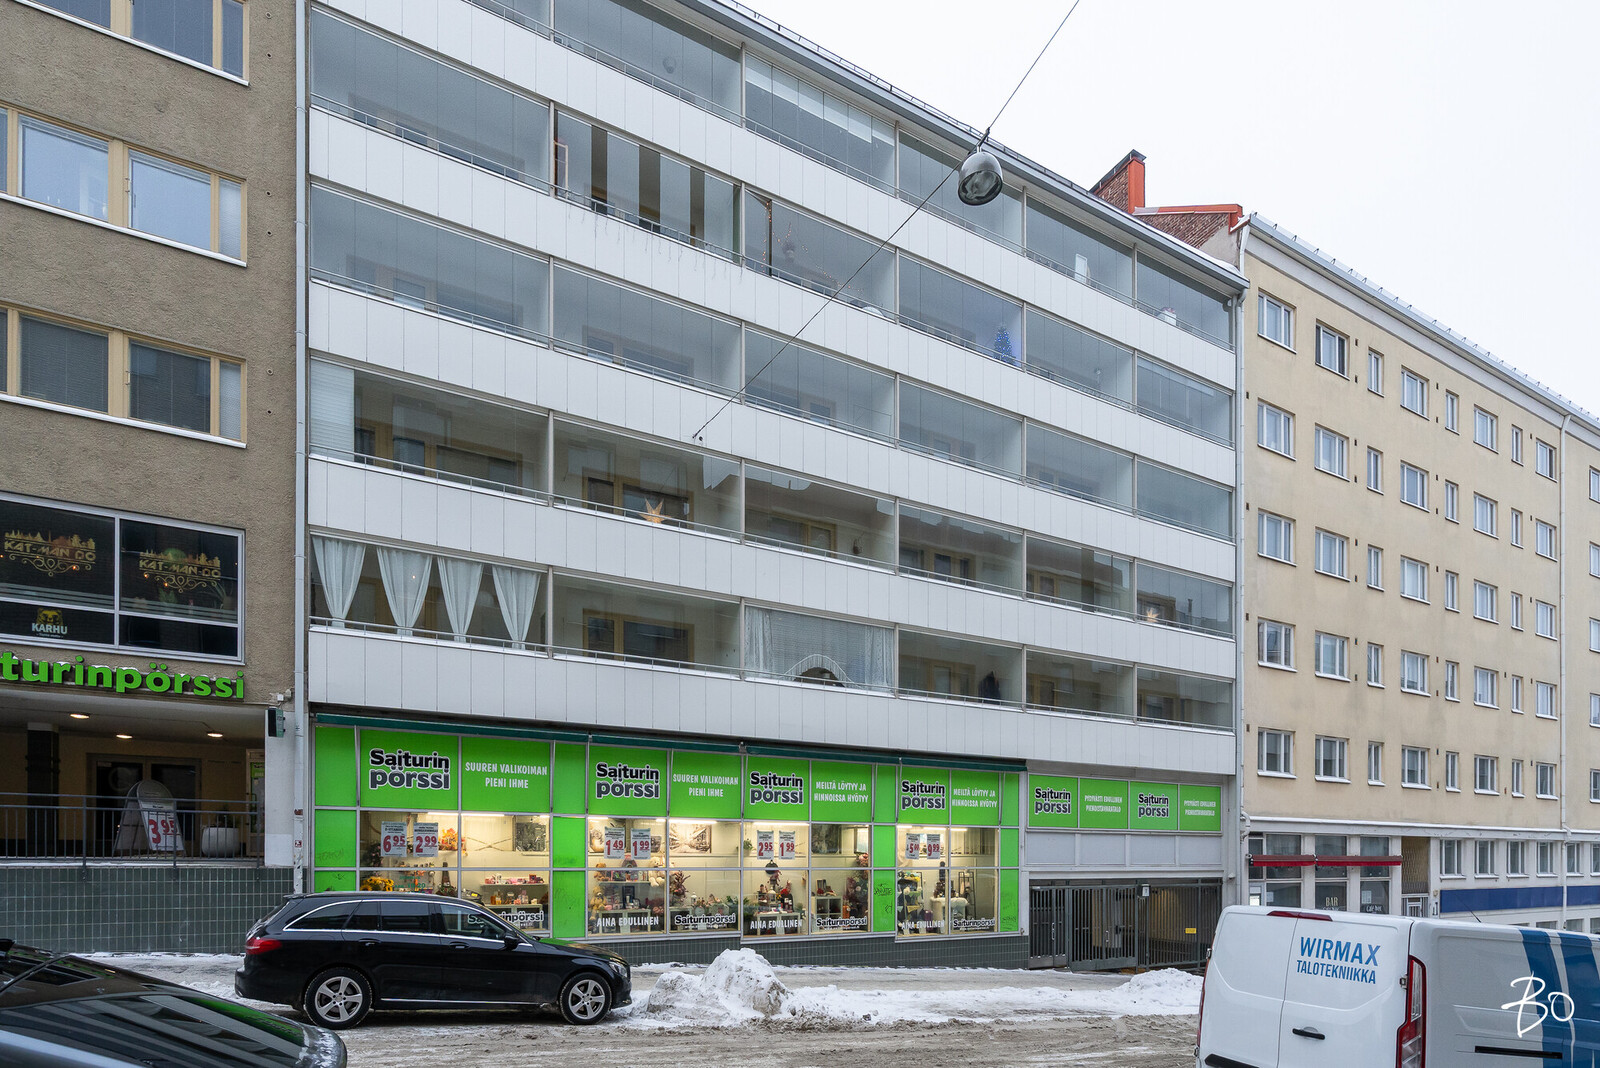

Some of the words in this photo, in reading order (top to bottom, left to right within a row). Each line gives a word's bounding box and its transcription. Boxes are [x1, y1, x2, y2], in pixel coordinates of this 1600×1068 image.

[32, 622, 68, 635] KARHU
[0, 651, 244, 699] turinpörssi
[369, 748, 450, 770] Saiturin
[465, 762, 498, 773] SUUREN
[499, 764, 548, 776] VALIKOIMAN
[596, 762, 660, 780] Saiturin
[369, 765, 450, 790] pörssi
[485, 777, 507, 788] PIENI
[508, 778, 529, 789] IHME
[672, 773, 699, 783] SUUREN
[700, 775, 739, 786] VALIKOIMAN
[750, 771, 803, 787] Saiturin
[596, 778, 660, 799] pörssi
[688, 787, 706, 797] PIENI
[707, 788, 724, 798] IHME
[815, 780, 837, 790] MEILTÄ
[837, 780, 858, 791] LÖYTYY
[858, 783, 867, 792] JA
[901, 780, 946, 795] Saiturin
[953, 787, 971, 797] MEILTÄ
[971, 788, 989, 797] LÖYTYY
[750, 785, 803, 805] pörssi
[813, 793, 846, 802] HINNOISSA
[847, 793, 869, 803] HYÖTYY
[1034, 786, 1072, 801] Saiturin
[1138, 792, 1169, 805] Saiturin
[901, 793, 946, 810] pörssi
[951, 799, 979, 807] HINNOISSA
[979, 798, 998, 808] HYÖTYY
[1034, 799, 1072, 815] pörssi
[1138, 803, 1169, 818] pörssi
[1325, 896, 1339, 907] BAR
[596, 918, 616, 927] AINA
[618, 916, 659, 926] EDULLINEN
[674, 913, 736, 926] Saiturinpörssi
[750, 920, 767, 930] AINA
[768, 919, 803, 929] EDULLINEN
[816, 916, 867, 927] Saiturinpörssi
[901, 921, 916, 930] AINA
[916, 919, 945, 929] EDULLINEN
[953, 917, 996, 928] Saiturinpörssi
[1301, 936, 1381, 967] WIRMAX
[1296, 959, 1376, 985] TALOTEKNIIKKA
